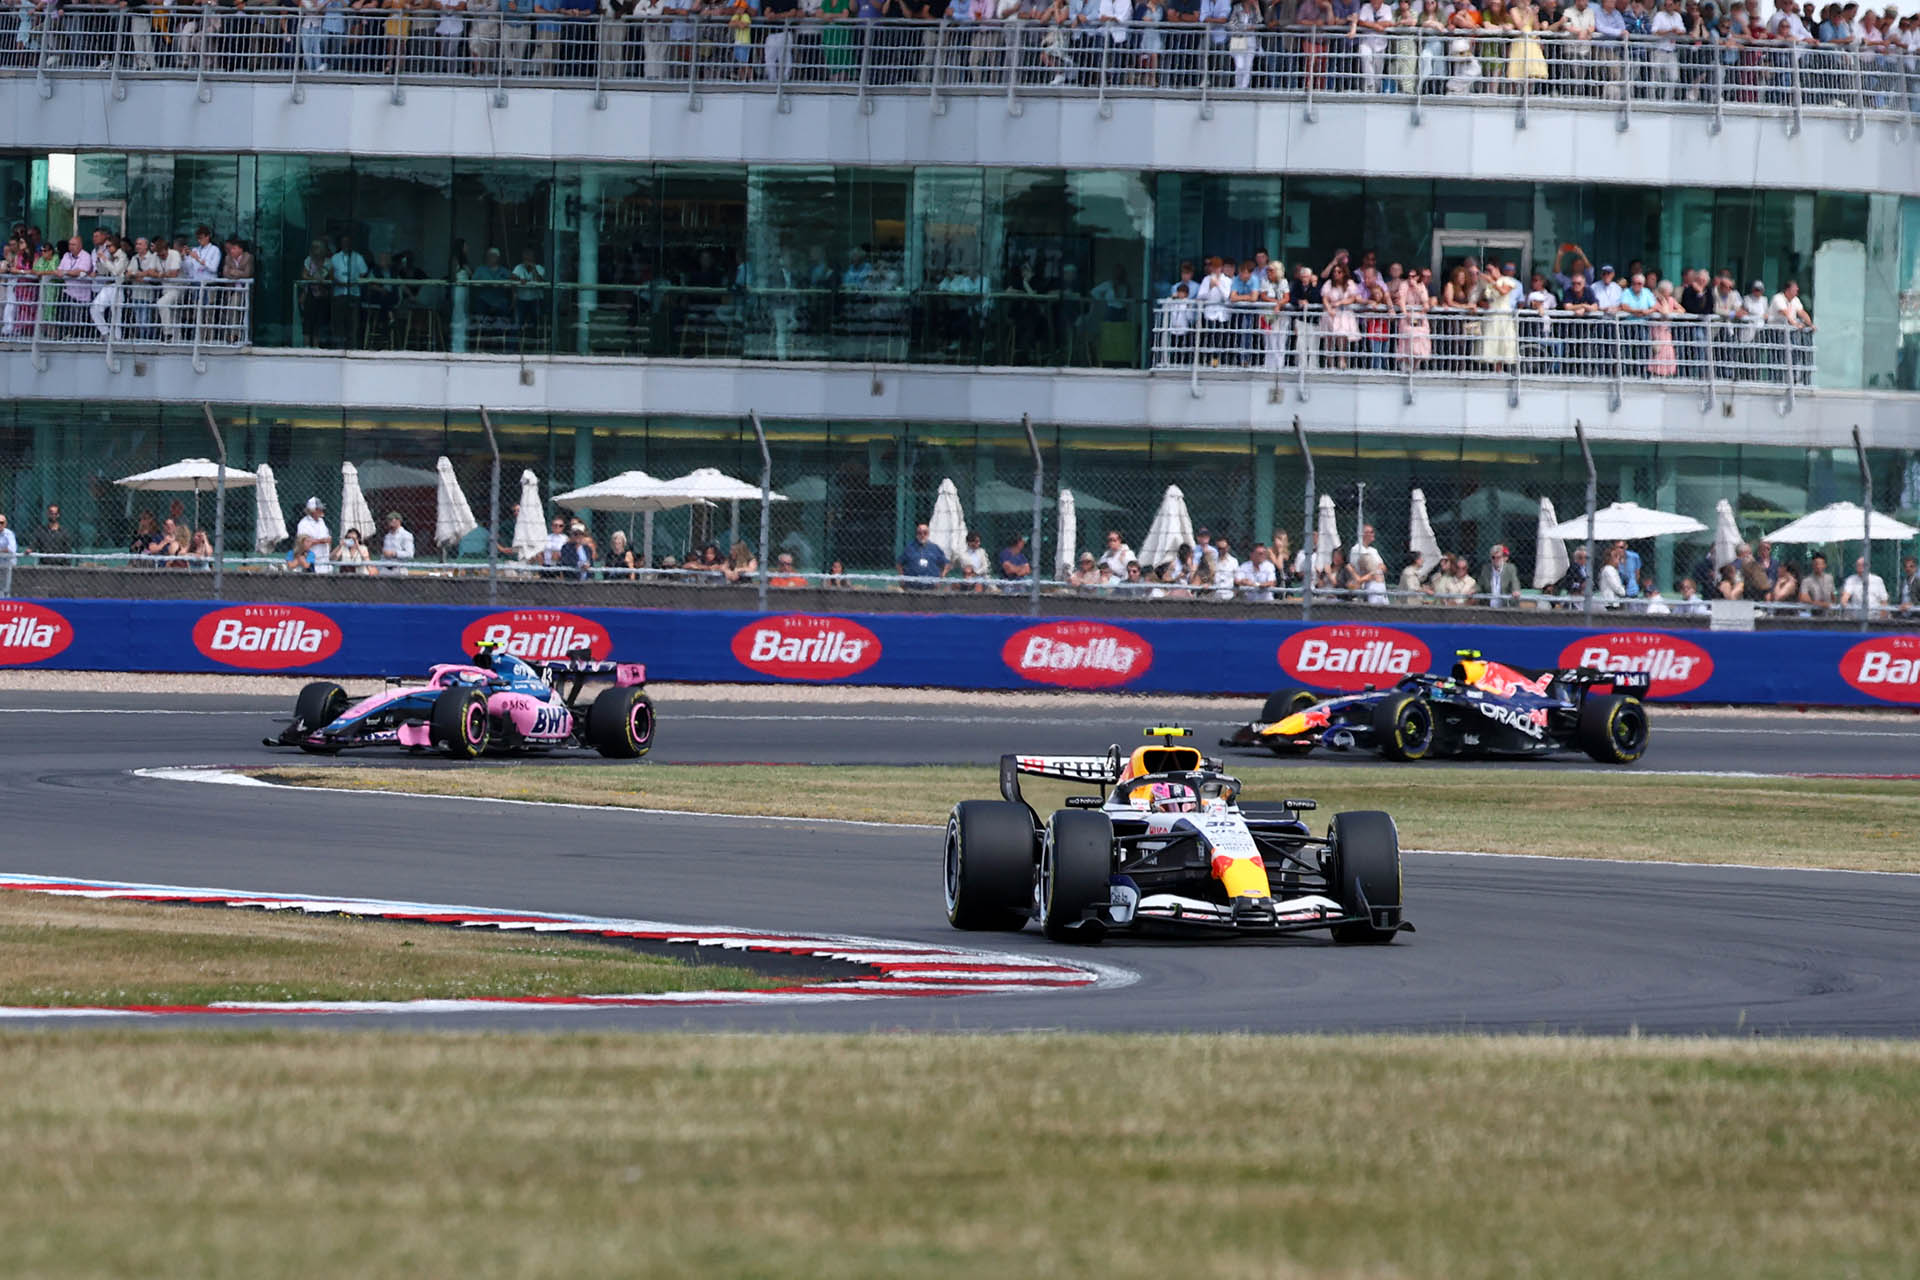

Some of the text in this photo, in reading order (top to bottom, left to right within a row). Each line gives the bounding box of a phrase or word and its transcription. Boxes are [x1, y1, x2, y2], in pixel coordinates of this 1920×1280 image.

[211, 619, 323, 652] Barilla
[480, 625, 592, 657] Barilla
[750, 629, 862, 663] Barilla
[1021, 636, 1135, 673] Barilla
[1297, 640, 1412, 673] Barilla
[1580, 648, 1693, 680] Barilla
[509, 700, 530, 711] MSC
[530, 708, 569, 736] BWT
[1480, 703, 1544, 740] ORACLE
